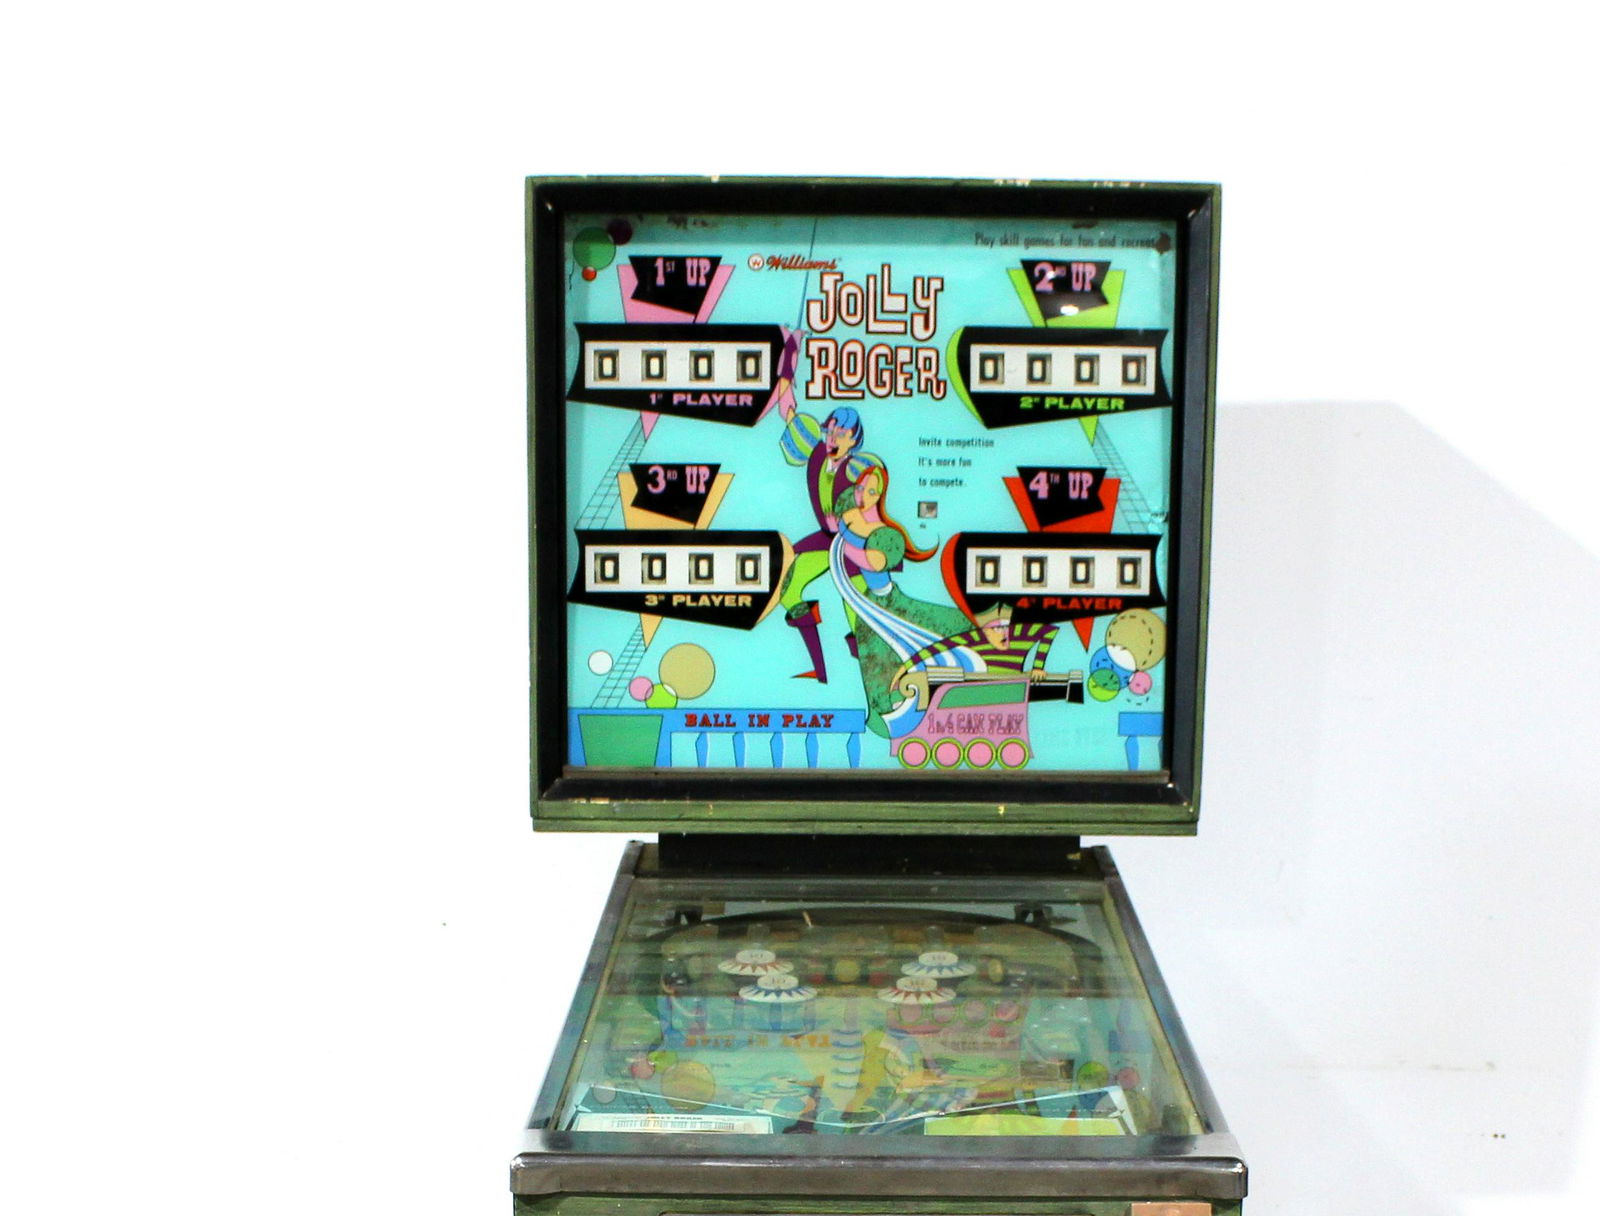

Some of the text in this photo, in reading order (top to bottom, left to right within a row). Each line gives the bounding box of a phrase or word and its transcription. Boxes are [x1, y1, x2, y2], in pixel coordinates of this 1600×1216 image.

[975, 231, 995, 248] Play
[1000, 232, 1020, 246] skill
[1024, 236, 1055, 249] games
[766, 254, 837, 271] Williams
[685, 257, 711, 287] UP
[1071, 261, 1096, 292] UP
[806, 263, 944, 341] JOLLY
[805, 338, 947, 400] ROGER
[673, 392, 753, 406] PLAYER
[1044, 396, 1125, 410] PLAYER
[918, 437, 995, 449] Invite competition
[918, 456, 972, 467] It's more fun
[685, 465, 710, 494] UP
[918, 478, 927, 487] to
[1068, 471, 1093, 499] UP
[672, 593, 753, 607] PLAYER
[1043, 596, 1123, 610] PLAYER
[684, 713, 834, 728] BALL IN PLAY
[928, 712, 935, 734] 1
[945, 712, 954, 734] 4
[956, 712, 985, 735] CAN
[988, 712, 1025, 735] PLAY
